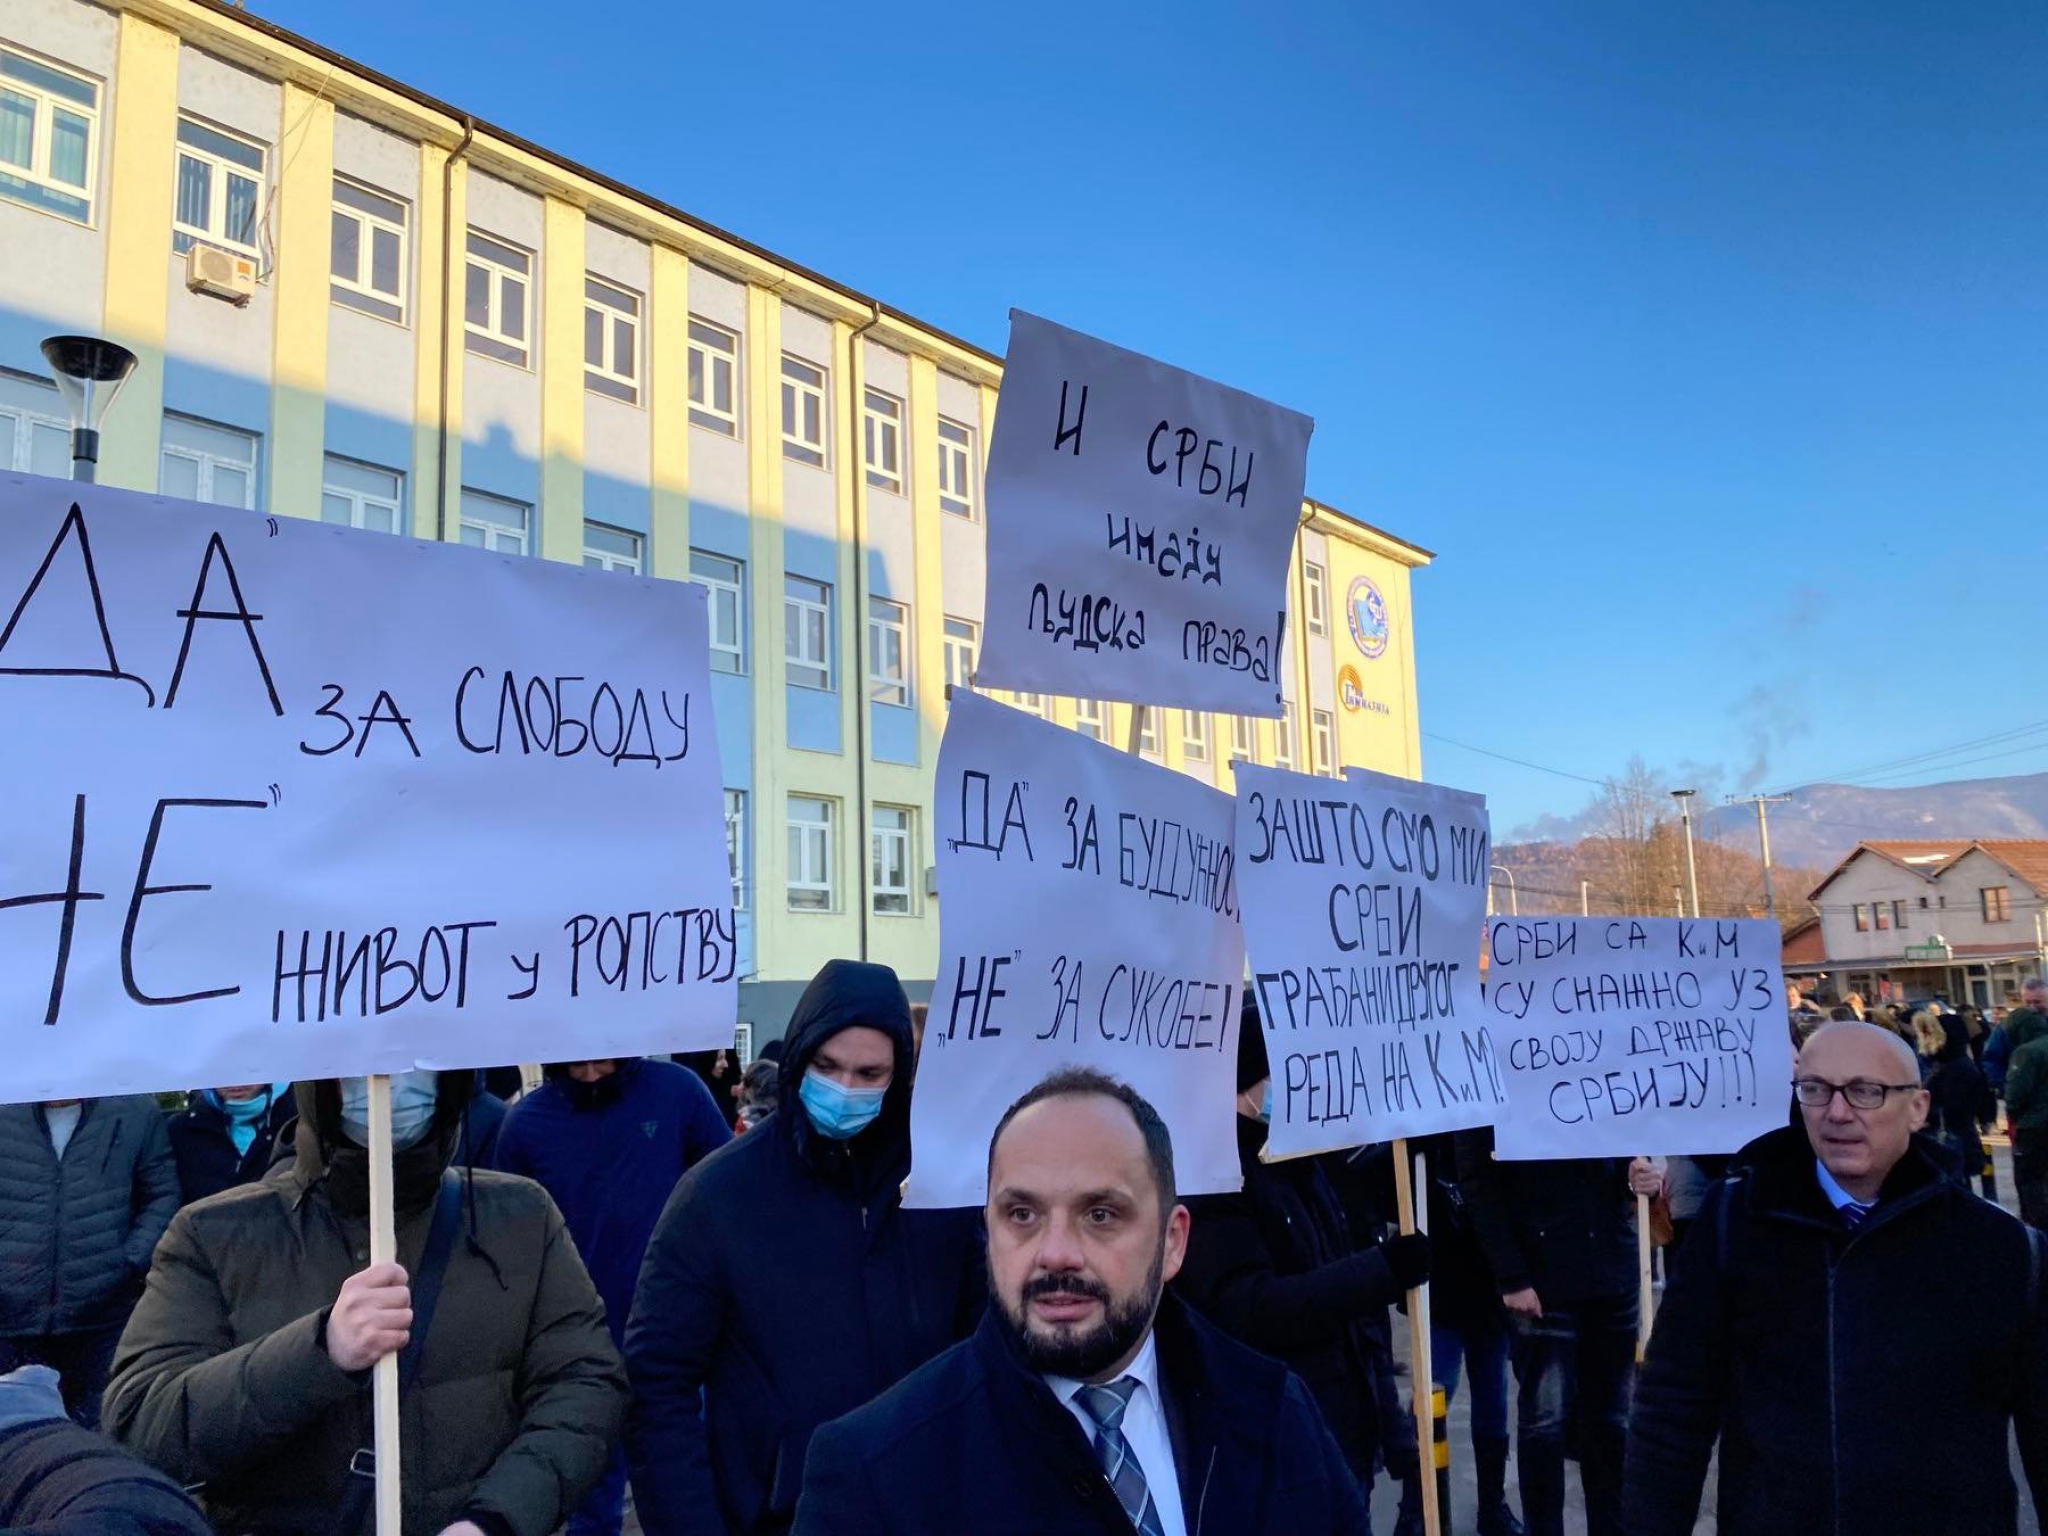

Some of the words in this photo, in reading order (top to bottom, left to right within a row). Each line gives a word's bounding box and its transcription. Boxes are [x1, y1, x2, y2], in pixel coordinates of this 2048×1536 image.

[1054, 381, 1088, 456] И
[1146, 419, 1254, 509] СРБИ
[299, 683, 422, 758] ЗА
[455, 666, 691, 770] СЛОБОДУ
[1061, 796, 1101, 876] ЗА
[1119, 812, 1240, 924] БУДУЋНОС
[1249, 791, 1375, 870] ЗАШТО
[1381, 806, 1440, 882] СМО
[1449, 825, 1487, 890] МИ
[271, 920, 497, 1024] ЖИВОТ
[564, 907, 739, 998] РОПСТВУ
[1328, 883, 1421, 958] СРБИ
[1492, 921, 1576, 966] СРБИ
[1605, 921, 1647, 950] СА
[1036, 955, 1083, 1044] ЗА
[1099, 963, 1233, 1053] СУКОБЕ!
[1494, 979, 1535, 1019] СУ
[1552, 971, 1701, 1014] СНАЖНО
[1723, 967, 1773, 1011] УЗ
[1284, 1046, 1373, 1129] РЕДА
[1382, 1040, 1423, 1114] НА
[1510, 1029, 1603, 1071] СВОЈУ
[1626, 1016, 1756, 1056] ДРЖАВУ
[1549, 1050, 1757, 1125] СРБИЈУ!!!
